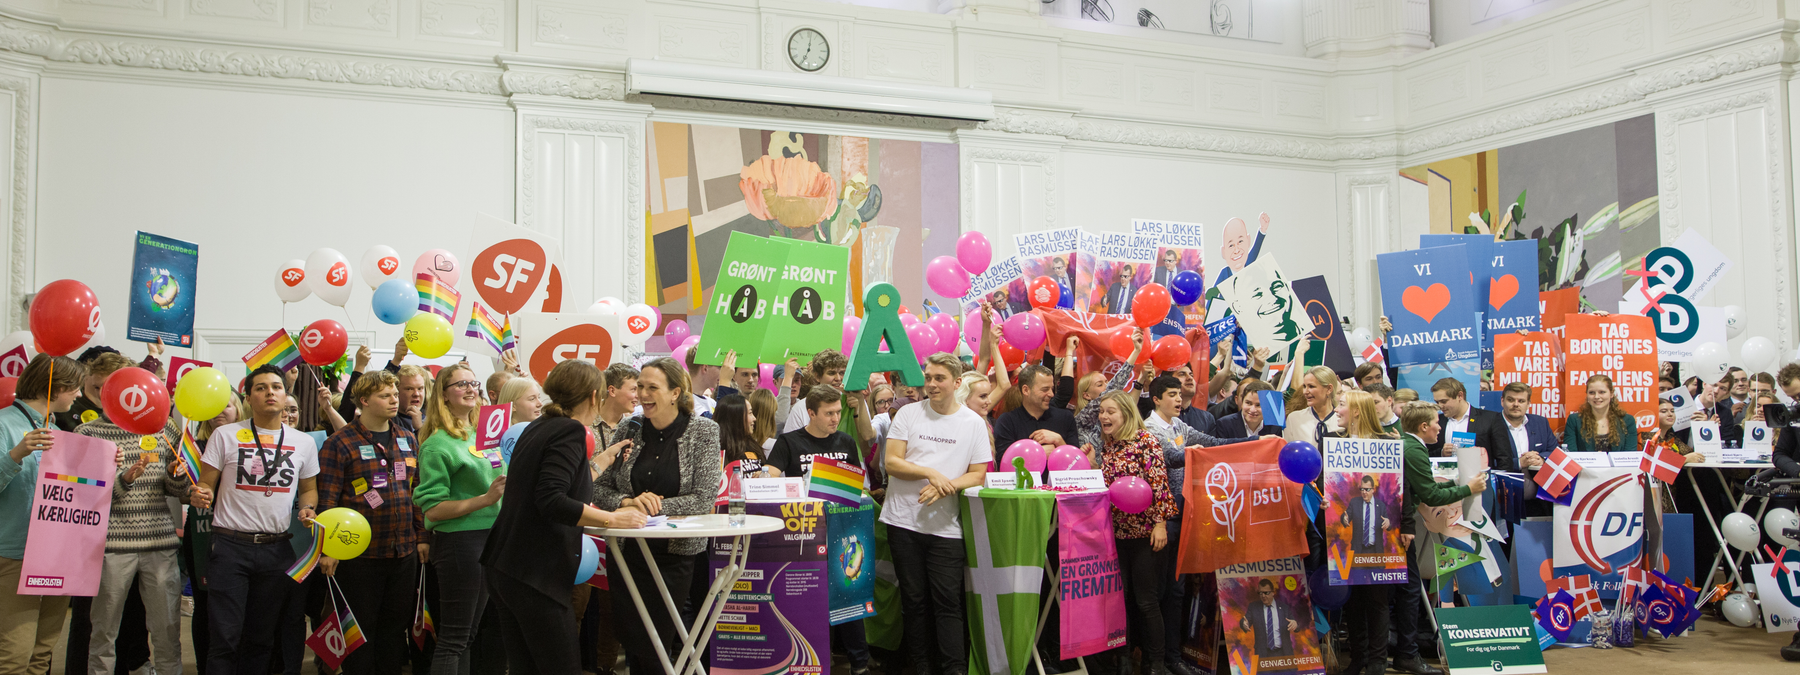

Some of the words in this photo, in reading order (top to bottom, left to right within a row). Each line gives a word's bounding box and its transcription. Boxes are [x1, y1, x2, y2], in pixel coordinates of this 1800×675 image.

[1134, 221, 1162, 233] LARS
[1166, 223, 1201, 236] LØKKE
[1016, 233, 1044, 246] LARS
[1102, 234, 1126, 247] LARS
[1128, 236, 1158, 249] LØKKE
[1018, 239, 1078, 257] RASMUSSE
[1100, 246, 1157, 260] RASMUSSEN
[381, 259, 397, 270] SF
[728, 260, 777, 283] GRØNT
[985, 256, 1019, 280] LØKKE
[1413, 263, 1432, 276] VI
[1706, 261, 1726, 283] ungdom
[285, 270, 302, 281] SF
[331, 267, 345, 282] SF
[484, 253, 536, 293] SF
[715, 287, 767, 319] HÅB
[772, 289, 836, 320] HÅB
[630, 317, 648, 331] SF
[1163, 317, 1186, 335] ENSTRE
[1312, 315, 1326, 326] LA
[1487, 315, 1536, 330] NMARK
[1391, 327, 1473, 348] DANMARK
[1600, 323, 1630, 338] TAG
[1523, 341, 1550, 356] TAG
[1569, 339, 1653, 354] BØRNENES
[1514, 356, 1550, 372] VARE
[1602, 355, 1624, 370] OG
[1541, 388, 1560, 403] OG
[1614, 387, 1650, 402] ARTI
[1635, 414, 1656, 428] KD
[919, 434, 957, 444] KLIMAOPRØR
[1327, 441, 1359, 454] LARS
[1362, 442, 1400, 456] LØKKE
[238, 447, 295, 469] FCK
[1327, 455, 1400, 469] RASMUSSEN
[236, 466, 295, 487] NZS
[42, 484, 74, 503] VÆLG
[1253, 486, 1283, 506] DSU
[37, 504, 101, 526] KÆRLIGHED
[780, 501, 824, 517] KICK
[785, 517, 817, 532] OFF
[1600, 512, 1643, 537] DF
[1219, 557, 1302, 575] RASMUSSEN
[1354, 556, 1382, 564] GENVÆLG
[1382, 555, 1405, 563] CHEFEN!
[1061, 565, 1076, 579] EN
[1371, 571, 1407, 581] VENSTRE
[1556, 609, 1565, 624] DF
[1653, 606, 1667, 618] DF
[1448, 627, 1530, 639] KONSERVATIVT
[1260, 660, 1292, 668] GENVÆLG
[1293, 656, 1321, 666] CHEFEN!
